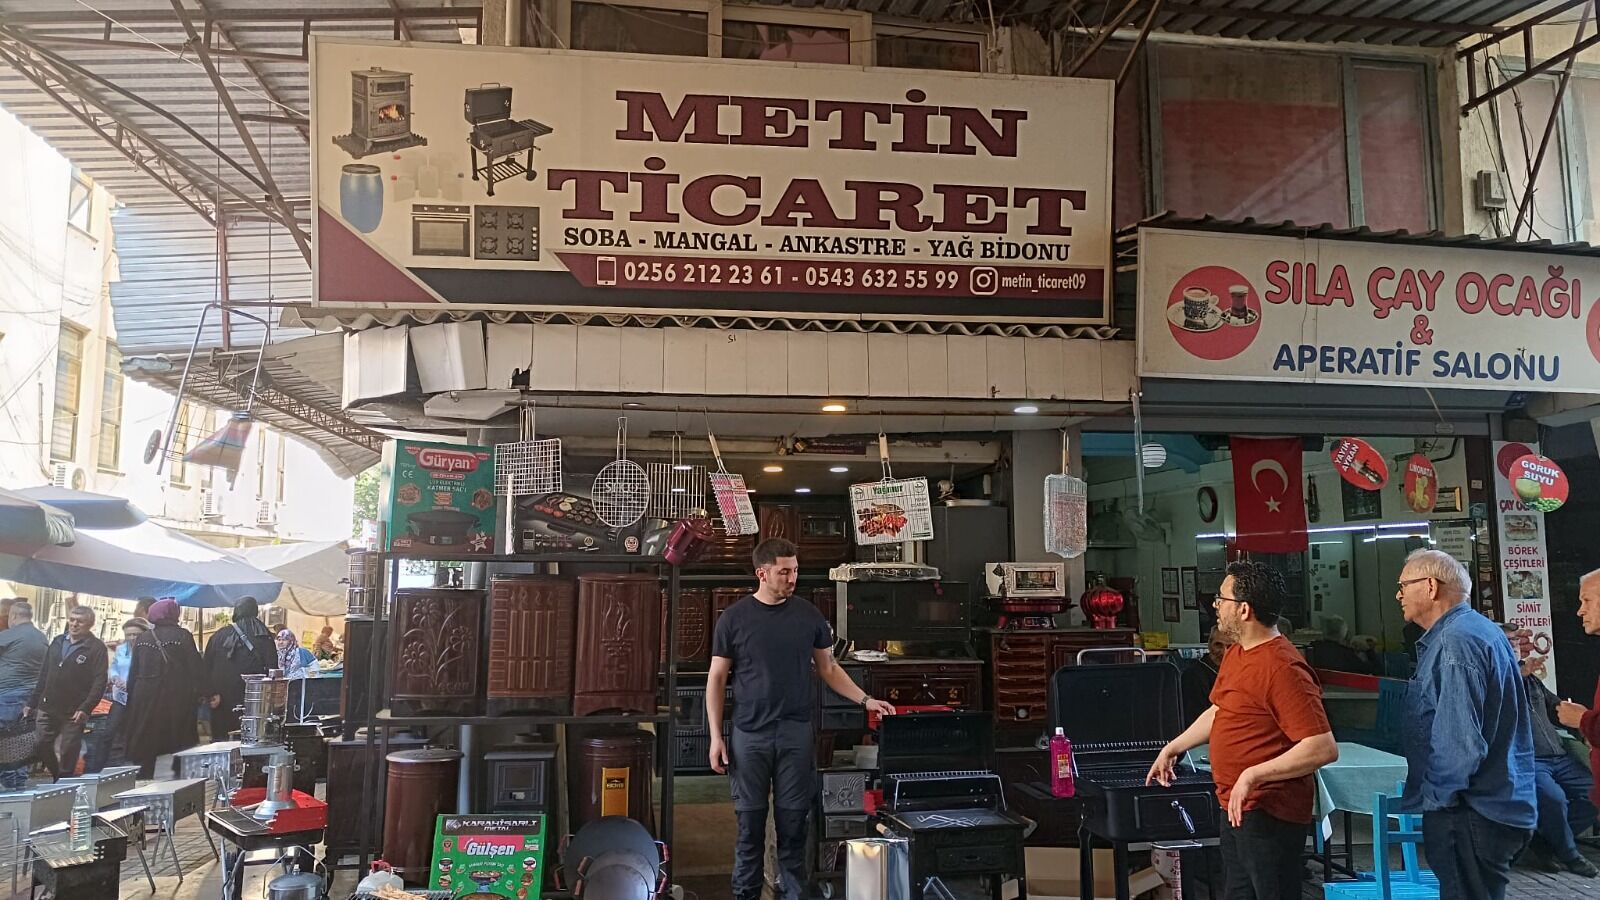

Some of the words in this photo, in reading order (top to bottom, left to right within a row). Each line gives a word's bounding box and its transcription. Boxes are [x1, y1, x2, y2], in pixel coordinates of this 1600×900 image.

[615, 89, 1028, 158] METİN
[547, 156, 1086, 236] TİCARET
[564, 227, 632, 248] SOBA
[654, 231, 758, 251] MANGAL
[779, 235, 906, 256] ANKASTRE
[928, 235, 974, 258] YAĞ
[980, 236, 1070, 261] BİDONU
[624, 262, 676, 282] 0256
[683, 264, 722, 283] 212
[728, 265, 753, 284] 23
[760, 266, 782, 285] 61
[805, 267, 854, 287] 0543
[861, 269, 898, 288] 632
[904, 270, 928, 289] 55
[935, 271, 959, 289] 99
[1001, 272, 1087, 293] metin_ticaret09
[1265, 260, 1354, 307] SILA
[1367, 266, 1445, 319] ÇAY
[1455, 265, 1581, 319] OCAĞI
[1410, 314, 1434, 345] &
[1273, 341, 1421, 376] APERATİF
[1433, 350, 1559, 381] SALONU
[420, 448, 471, 472] Güryan
[1334, 440, 1351, 464] YAYIK
[1342, 443, 1359, 472] AYRAN
[1521, 460, 1560, 478] GORUK
[1523, 470, 1554, 486] SUYU
[1499, 500, 1515, 513] ÇAY
[1508, 544, 1539, 555] BÖREK
[1503, 557, 1545, 569] ÇEŞİTLERİ
[1516, 601, 1541, 614] SİMİT
[467, 842, 516, 859] Gülşen
